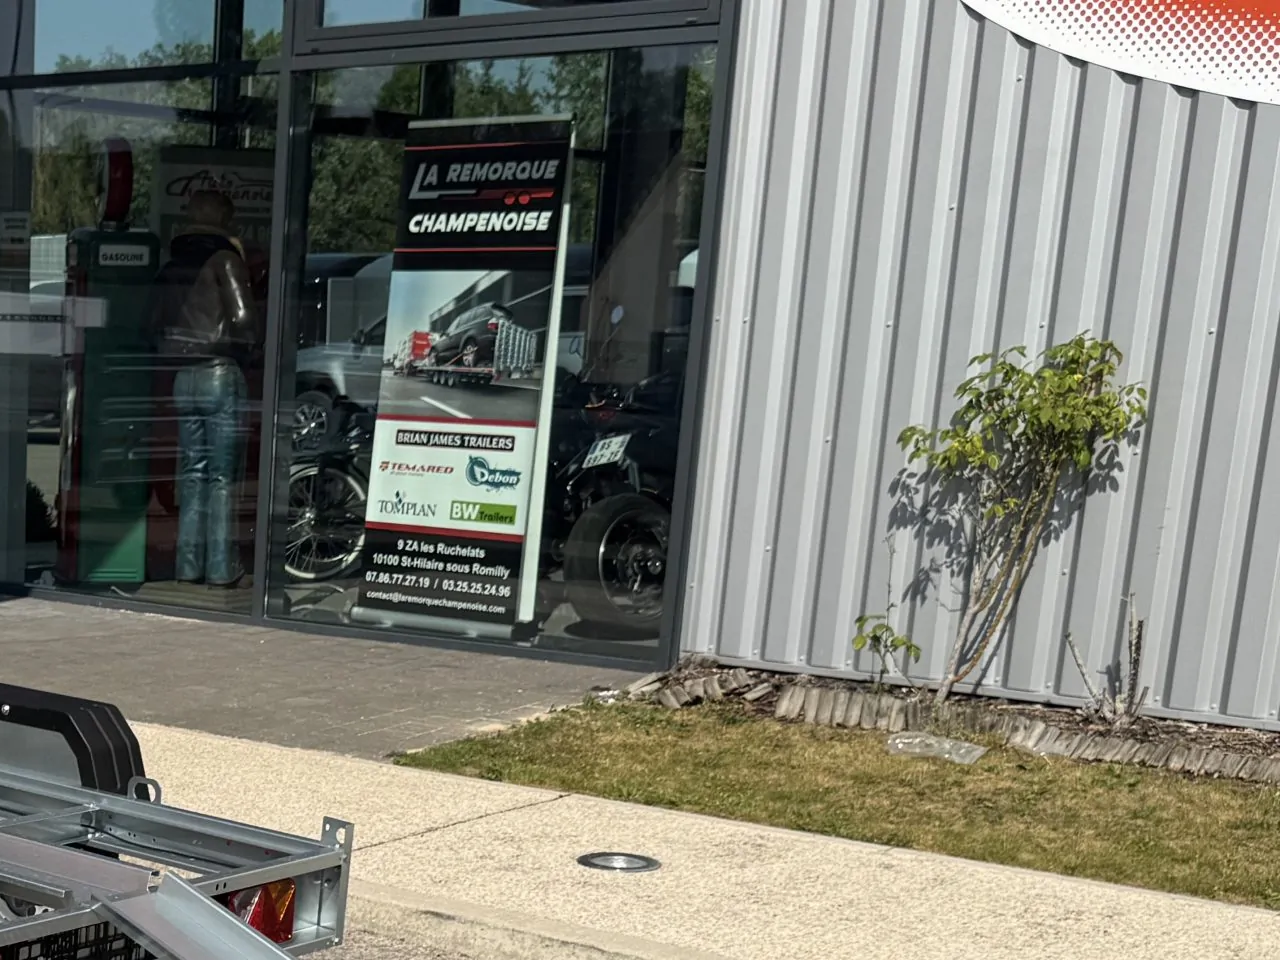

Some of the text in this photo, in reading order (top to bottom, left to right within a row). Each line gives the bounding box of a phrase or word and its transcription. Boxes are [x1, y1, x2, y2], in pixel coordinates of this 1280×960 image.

[408, 159, 560, 200] LA REMORQUE
[408, 210, 552, 234] CHAMPENOISE
[397, 432, 513, 450] BRIAN JAMES TRAILERS
[390, 462, 454, 475] TEMARED
[473, 465, 518, 484] Debon
[378, 499, 437, 518] TOMPLAN
[451, 502, 514, 523] BW Trailers
[397, 539, 405, 550] 9
[405, 540, 419, 552] ZA
[420, 541, 435, 553] les
[372, 553, 511, 580] 10100 St-Hilaire sous Romilly
[433, 578, 439, 590] /
[442, 579, 511, 597] 03.25.25.24.96
